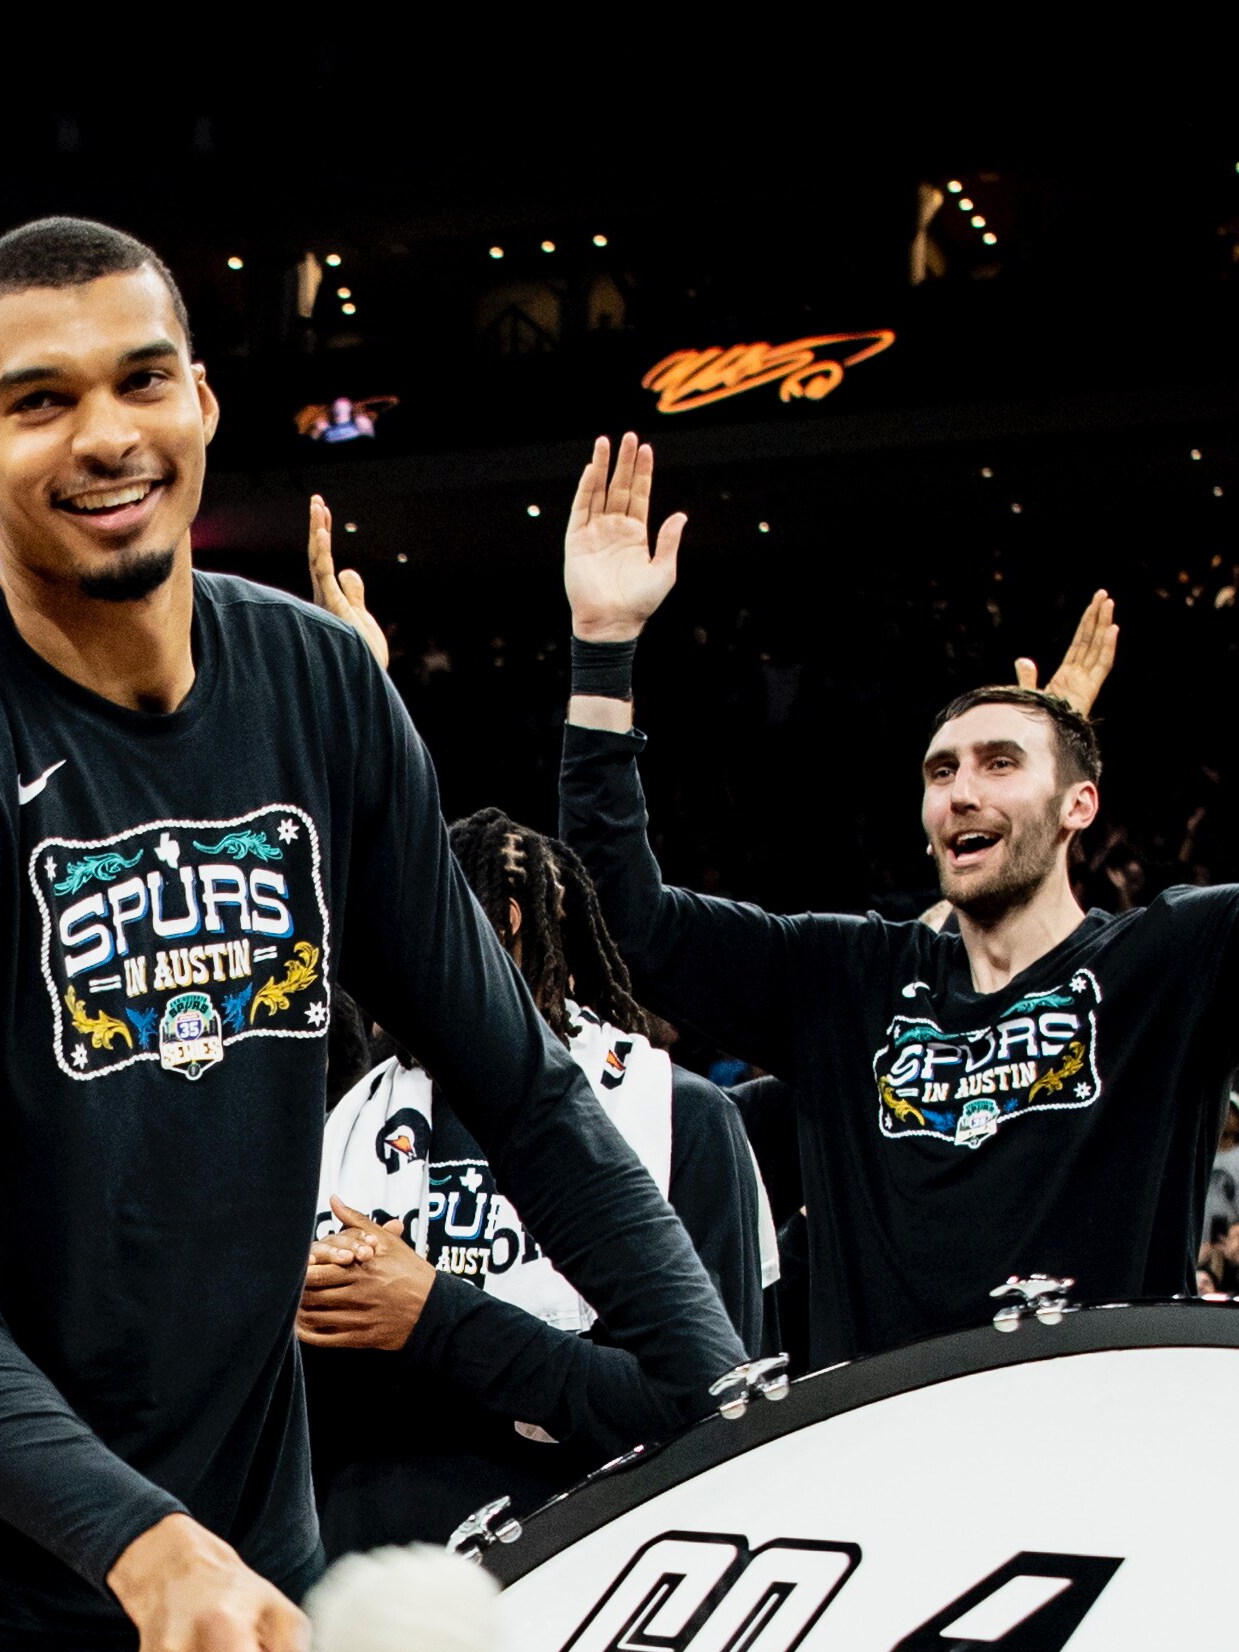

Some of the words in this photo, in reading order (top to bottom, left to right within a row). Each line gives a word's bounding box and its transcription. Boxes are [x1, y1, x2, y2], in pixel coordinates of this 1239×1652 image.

[60, 864, 294, 978] SPURS
[123, 954, 149, 998] IN
[153, 938, 252, 992] AUSTIN
[179, 1021, 200, 1039] 35
[887, 1012, 1081, 1087] SPURS
[921, 1081, 951, 1103] IN
[954, 1060, 1037, 1100] AUSTIN
[435, 1245, 492, 1276] AUST
